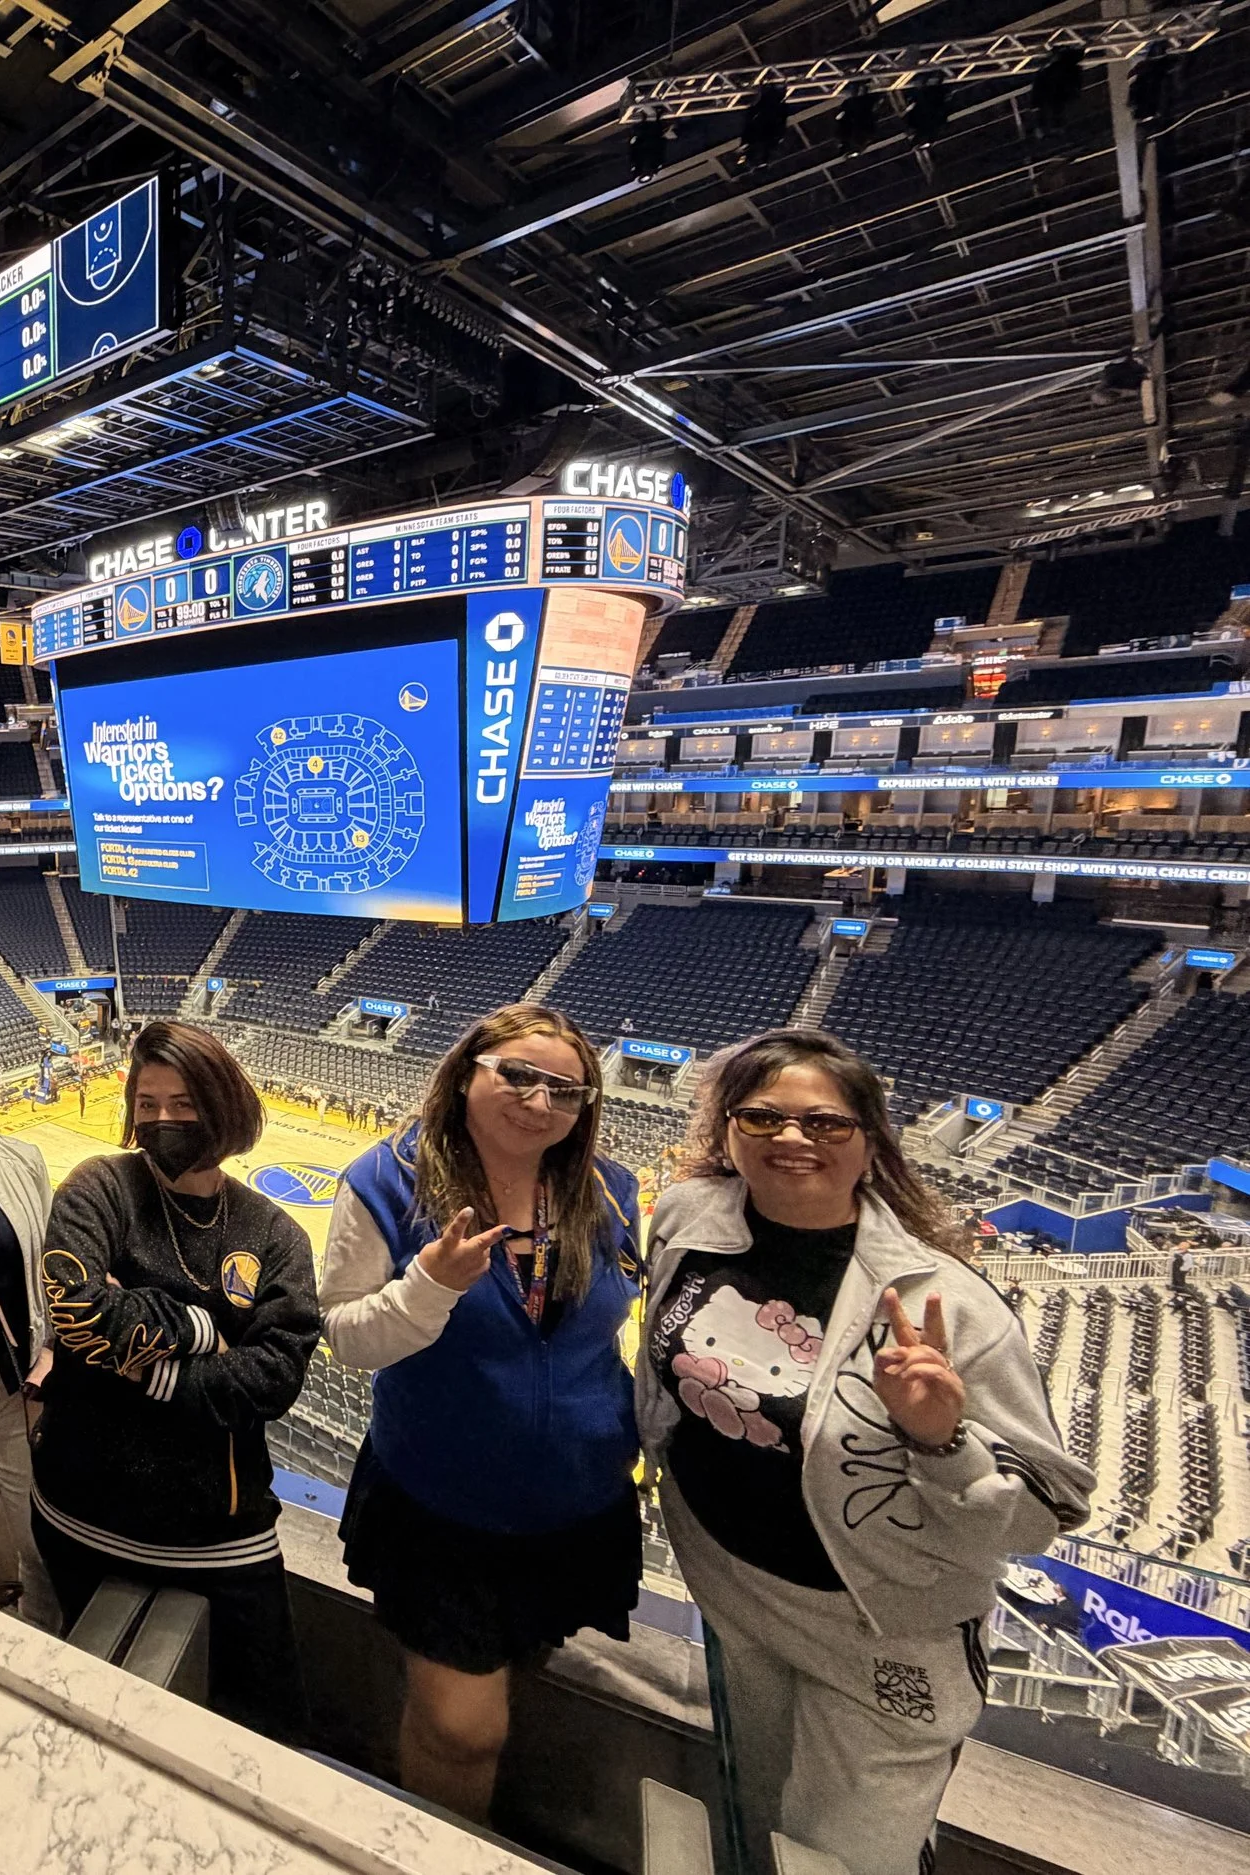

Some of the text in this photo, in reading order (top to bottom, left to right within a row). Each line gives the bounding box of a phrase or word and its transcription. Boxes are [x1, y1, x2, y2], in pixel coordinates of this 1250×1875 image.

[567, 462, 670, 505] CHASE
[553, 505, 596, 514] FOUR FACTORS
[395, 513, 478, 533] MINNESOTA TEAM STATS
[586, 521, 599, 533] 0.0
[90, 501, 327, 582] CHASE CNTER
[356, 547, 369, 556] AST
[394, 540, 401, 551] 0
[411, 538, 426, 546] BLK
[452, 530, 459, 541] 0
[506, 523, 522, 535] 0.0
[586, 536, 598, 547] 0.0
[658, 522, 667, 552] 0
[297, 537, 340, 551] FOUR FACTORS
[331, 550, 345, 561] 0.0
[393, 553, 400, 564] 0
[451, 544, 459, 555] 0
[505, 537, 521, 549] 0.0
[585, 550, 597, 561] 0.0
[331, 563, 345, 574] 0.0
[393, 567, 400, 577] 0
[410, 565, 426, 574] POT
[451, 558, 459, 569] 0
[469, 557, 487, 565] FG%
[505, 552, 521, 563] 0.0
[585, 564, 597, 575] 0.0
[204, 568, 217, 595] 0
[331, 576, 345, 587] 0.0
[393, 580, 400, 591] 0
[451, 572, 458, 583] 0
[469, 571, 486, 580] FT%
[504, 566, 520, 577] 0.0
[165, 577, 176, 603] 0
[301, 589, 345, 603] RATE 0.0
[209, 599, 221, 608] TOL
[157, 610, 167, 618] TOL
[176, 602, 205, 620] 99:00
[209, 611, 220, 619] FLS
[809, 721, 839, 730] HPE
[932, 714, 975, 725] Adobe
[92, 715, 157, 744] Interested in
[477, 658, 518, 803] CHASE
[693, 727, 730, 735] ORACLE
[273, 732, 284, 740] 42
[83, 741, 169, 765] Warriors
[106, 759, 175, 782] Ticket
[312, 760, 318, 769] 4
[751, 781, 787, 789] CHASE
[878, 776, 1059, 787] EXPERIENCE MORE WITH CHASE
[1160, 774, 1215, 784] CHASE
[119, 776, 224, 806] Options?
[632, 783, 655, 791] WITH
[655, 782, 683, 791] CHASE
[170, 816, 185, 824] one
[184, 814, 194, 824] of
[525, 811, 566, 826] Warriors
[356, 835, 365, 843] 13
[538, 831, 578, 851] Options?
[101, 843, 126, 853] PORTAL
[614, 850, 644, 858] CHASE
[102, 854, 128, 865] PORTAL
[102, 865, 128, 877] PORTAL
[728, 853, 749, 861] GET
[749, 853, 764, 862] $20
[766, 853, 784, 863] OFF
[784, 854, 843, 864] PURCHASES
[843, 855, 859, 865] OF
[859, 856, 884, 866] $100
[886, 857, 903, 866] OR
[904, 857, 939, 867] MORE
[939, 859, 955, 868] AT
[956, 859, 1008, 870] GOLDEN
[1009, 860, 1044, 871] STATE
[1044, 861, 1080, 873] SHOP
[1080, 864, 1117, 875] WITH
[1118, 865, 1158, 877] YOUR
[1158, 867, 1207, 879] CHASE
[365, 1002, 393, 1013] CHASE
[629, 1043, 669, 1057] CHASE
[310, 1131, 356, 1147] CHASE
[661, 1271, 706, 1335] Hello
[1084, 1588, 1159, 1645] Rak
[873, 1657, 929, 1679] LOEWE
